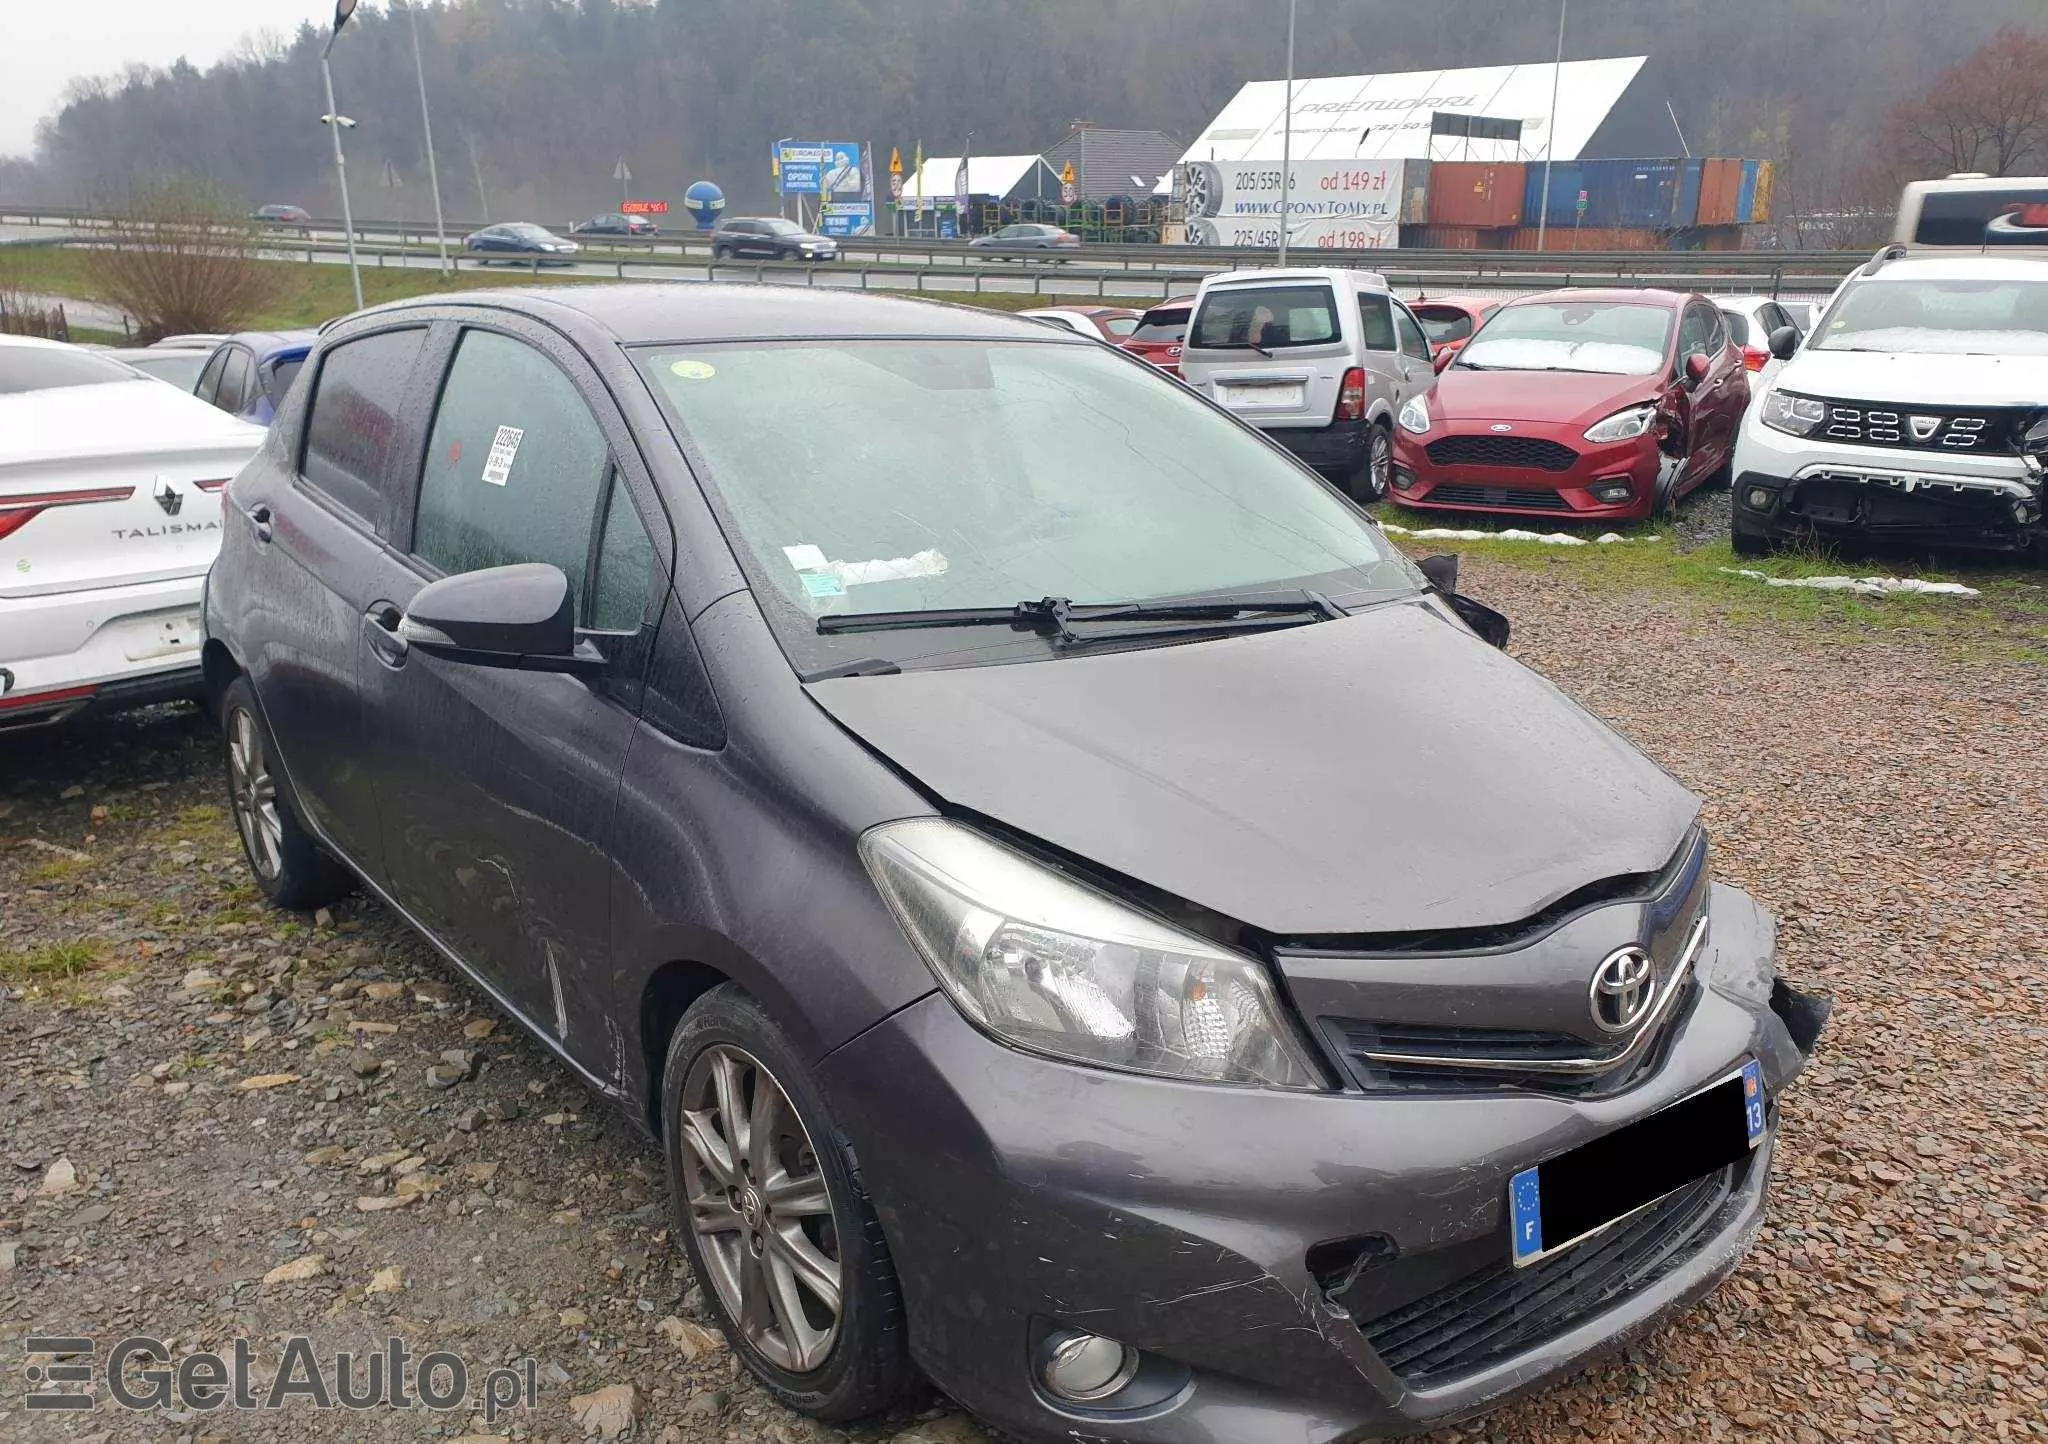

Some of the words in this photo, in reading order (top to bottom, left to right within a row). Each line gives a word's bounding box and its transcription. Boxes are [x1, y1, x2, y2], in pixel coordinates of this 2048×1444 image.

[1235, 172, 1296, 191] 205/55R6
[1320, 171, 1337, 190] od
[1343, 171, 1369, 191] 149
[1373, 169, 1387, 190] zł
[1234, 230, 1293, 248] 225/45R7
[1318, 232, 1334, 248] od
[1340, 231, 1364, 248] 198
[111, 520, 223, 540] TALISMA
[1747, 1101, 1763, 1132] 13
[1525, 1221, 1535, 1241] F
